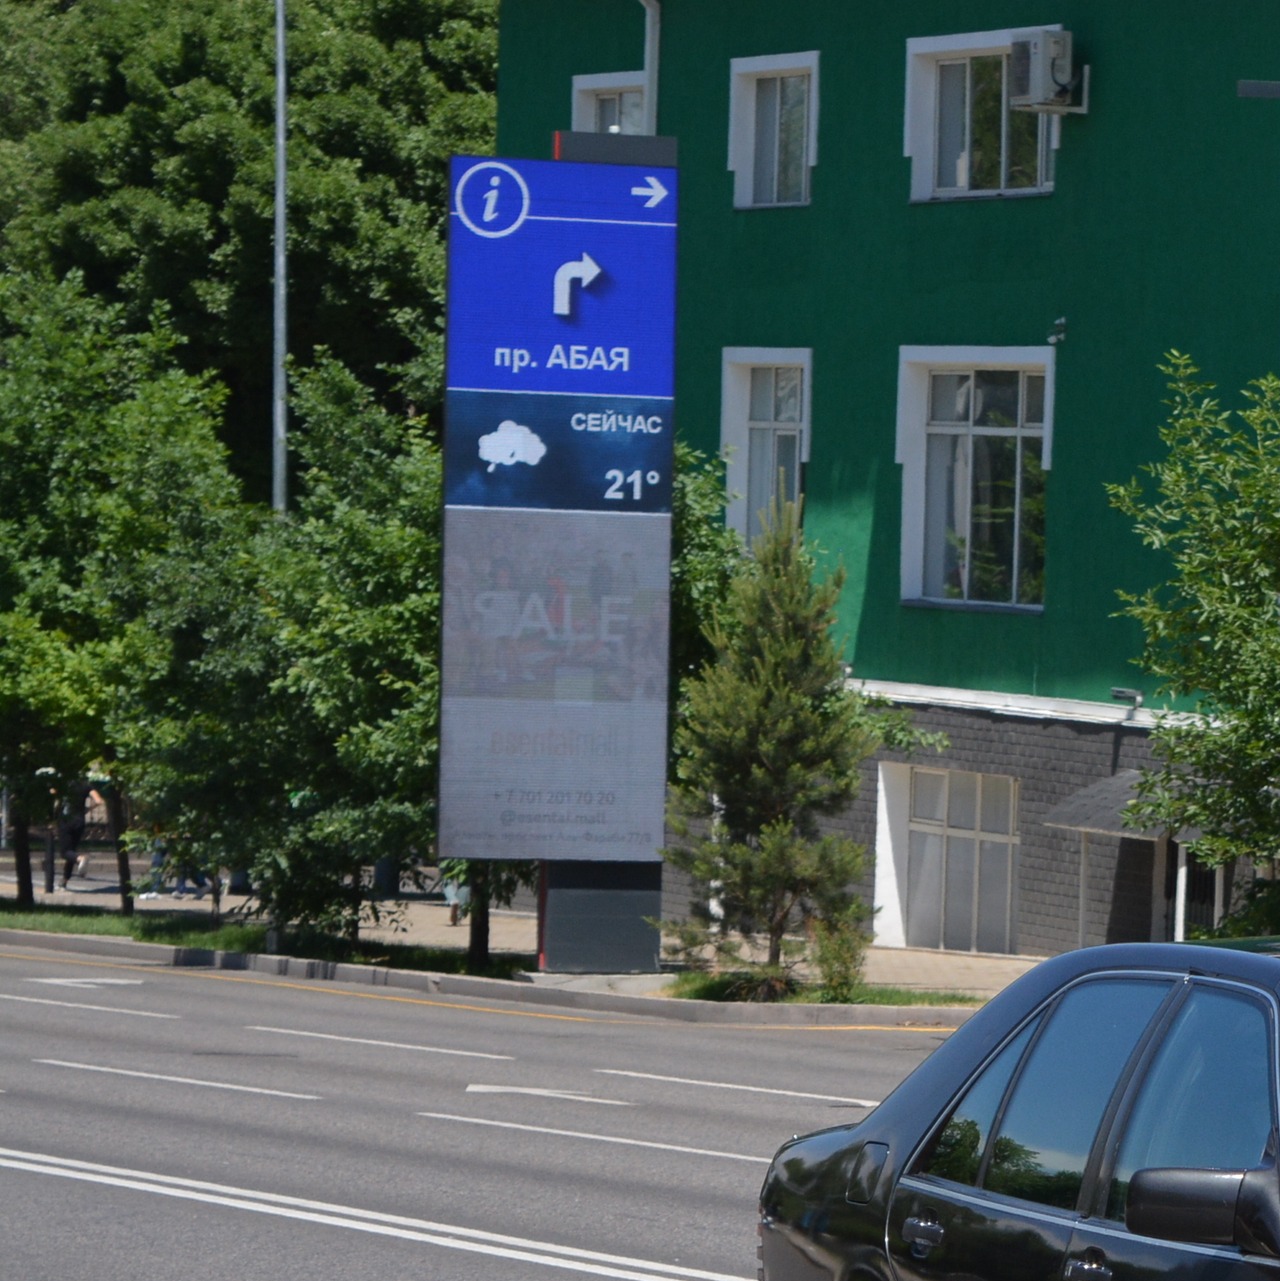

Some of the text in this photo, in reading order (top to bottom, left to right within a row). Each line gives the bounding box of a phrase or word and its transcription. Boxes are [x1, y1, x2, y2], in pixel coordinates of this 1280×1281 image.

[494, 344, 630, 373] пр. АБАЯ
[570, 409, 663, 434] СЕЙЧАС
